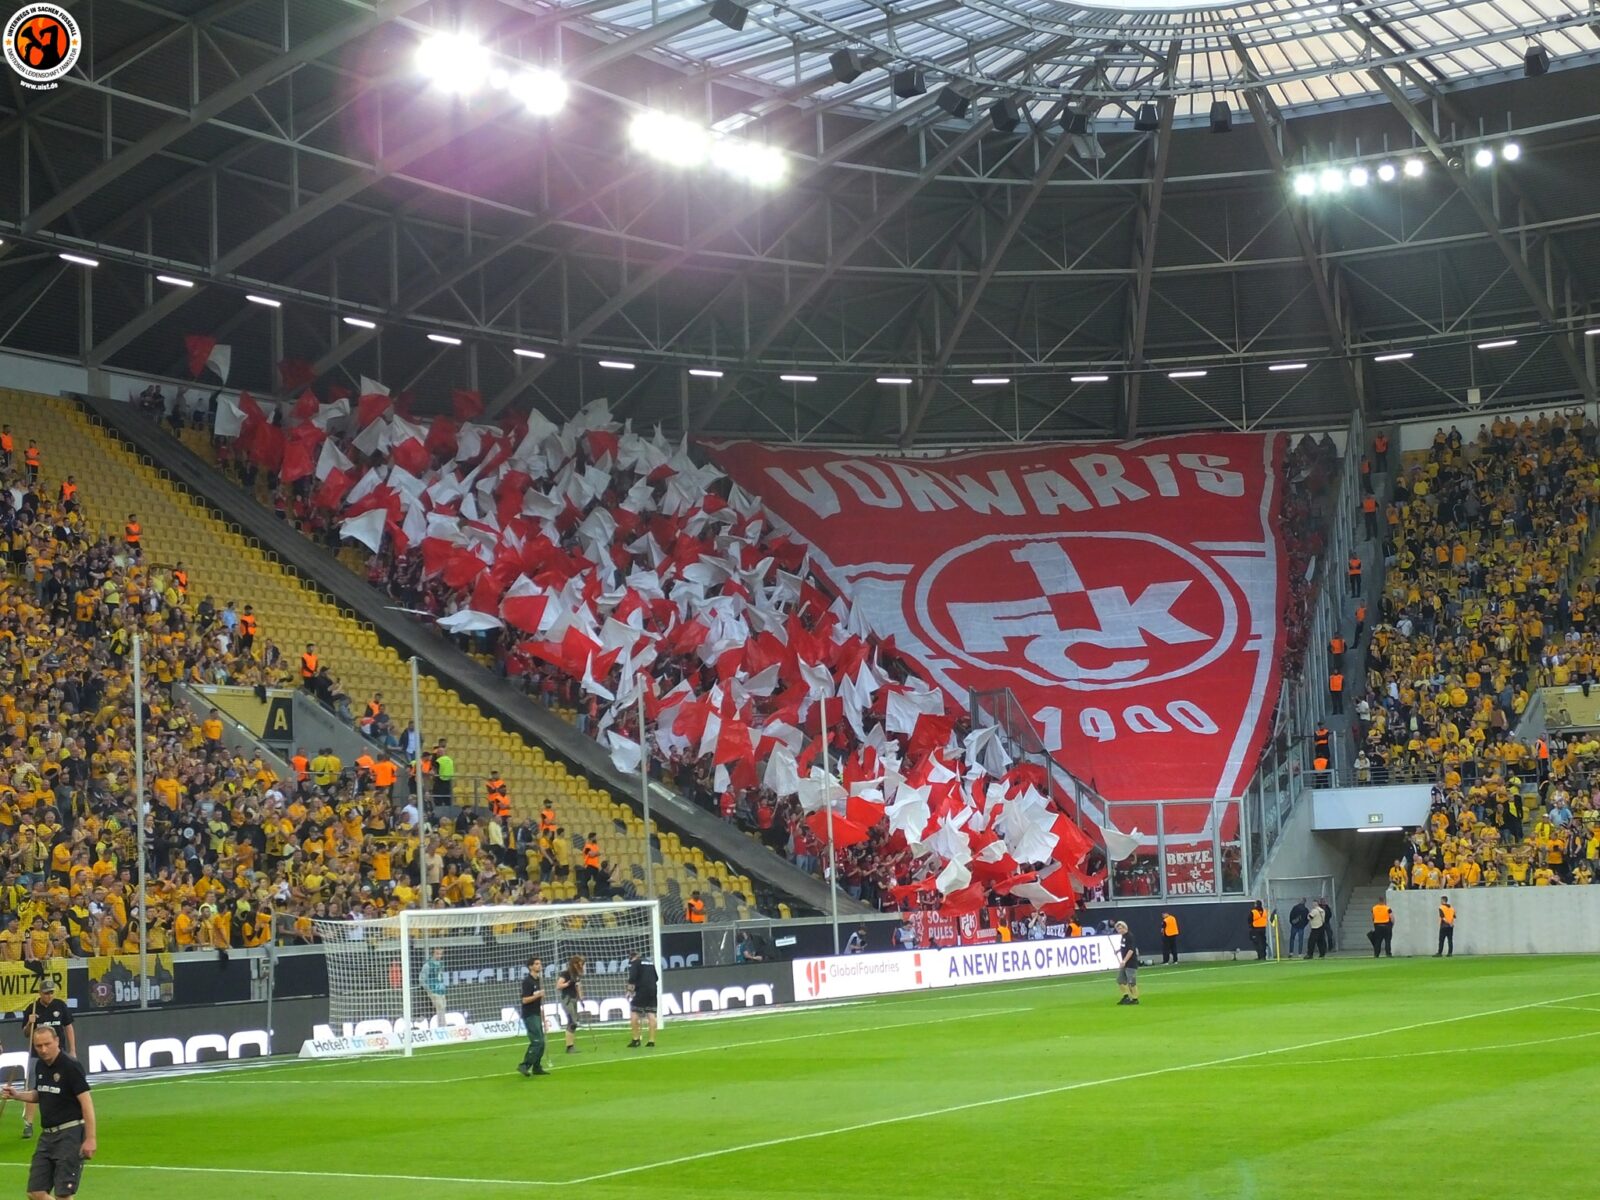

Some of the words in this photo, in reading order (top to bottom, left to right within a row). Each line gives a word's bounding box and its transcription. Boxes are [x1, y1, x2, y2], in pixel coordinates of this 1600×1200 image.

[273, 707, 288, 731] A
[1166, 850, 1213, 865] BETZE
[1169, 880, 1214, 894] JUNGS
[829, 960, 900, 978] GlobalFoundries
[949, 955, 960, 978] A
[962, 950, 998, 976] NEW
[1003, 946, 1032, 972] ERA
[1034, 944, 1053, 969] OF
[1056, 942, 1102, 967] MORE!
[0, 973, 63, 996] WITZR
[114, 979, 160, 1002] Döbln
[312, 1037, 349, 1053] Hotel?
